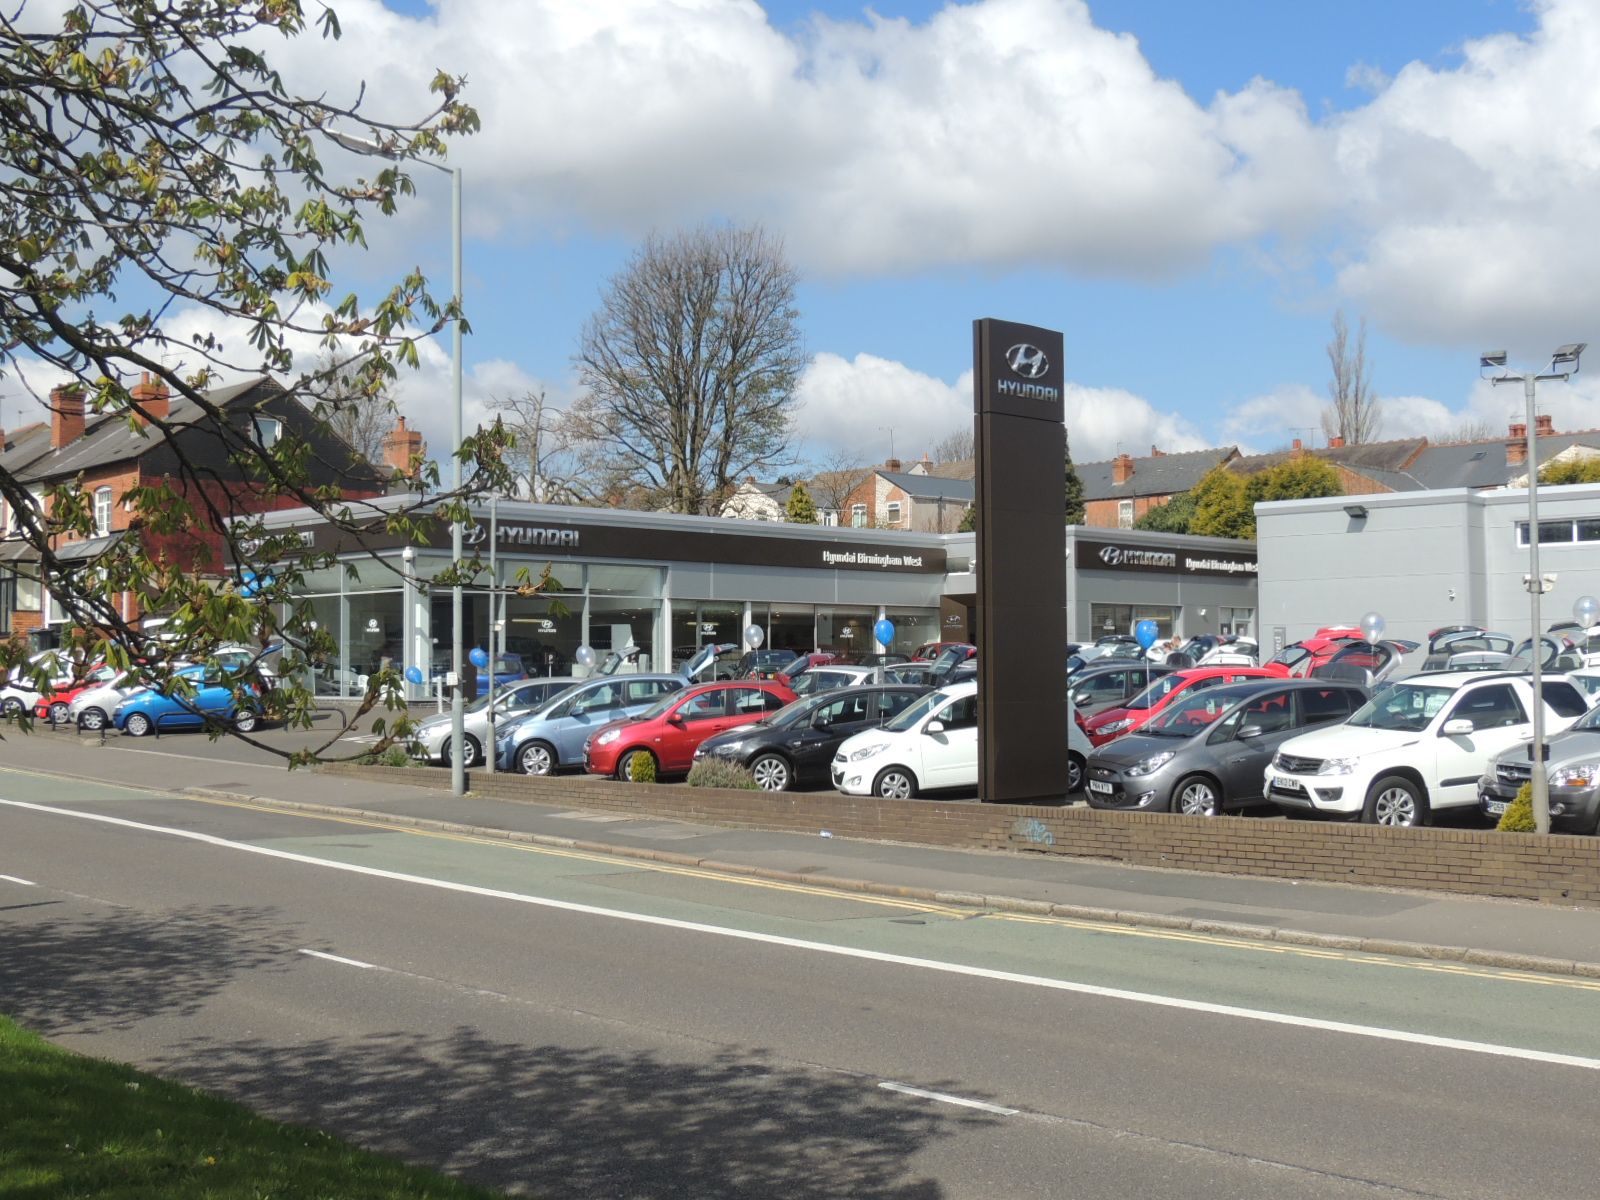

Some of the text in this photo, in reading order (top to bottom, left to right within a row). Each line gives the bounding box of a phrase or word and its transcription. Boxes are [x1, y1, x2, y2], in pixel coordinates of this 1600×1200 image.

[998, 379, 1058, 402] HYUNDAI
[496, 525, 580, 547] HYUNDAI
[823, 551, 922, 567] Hyundai Birmingham West
